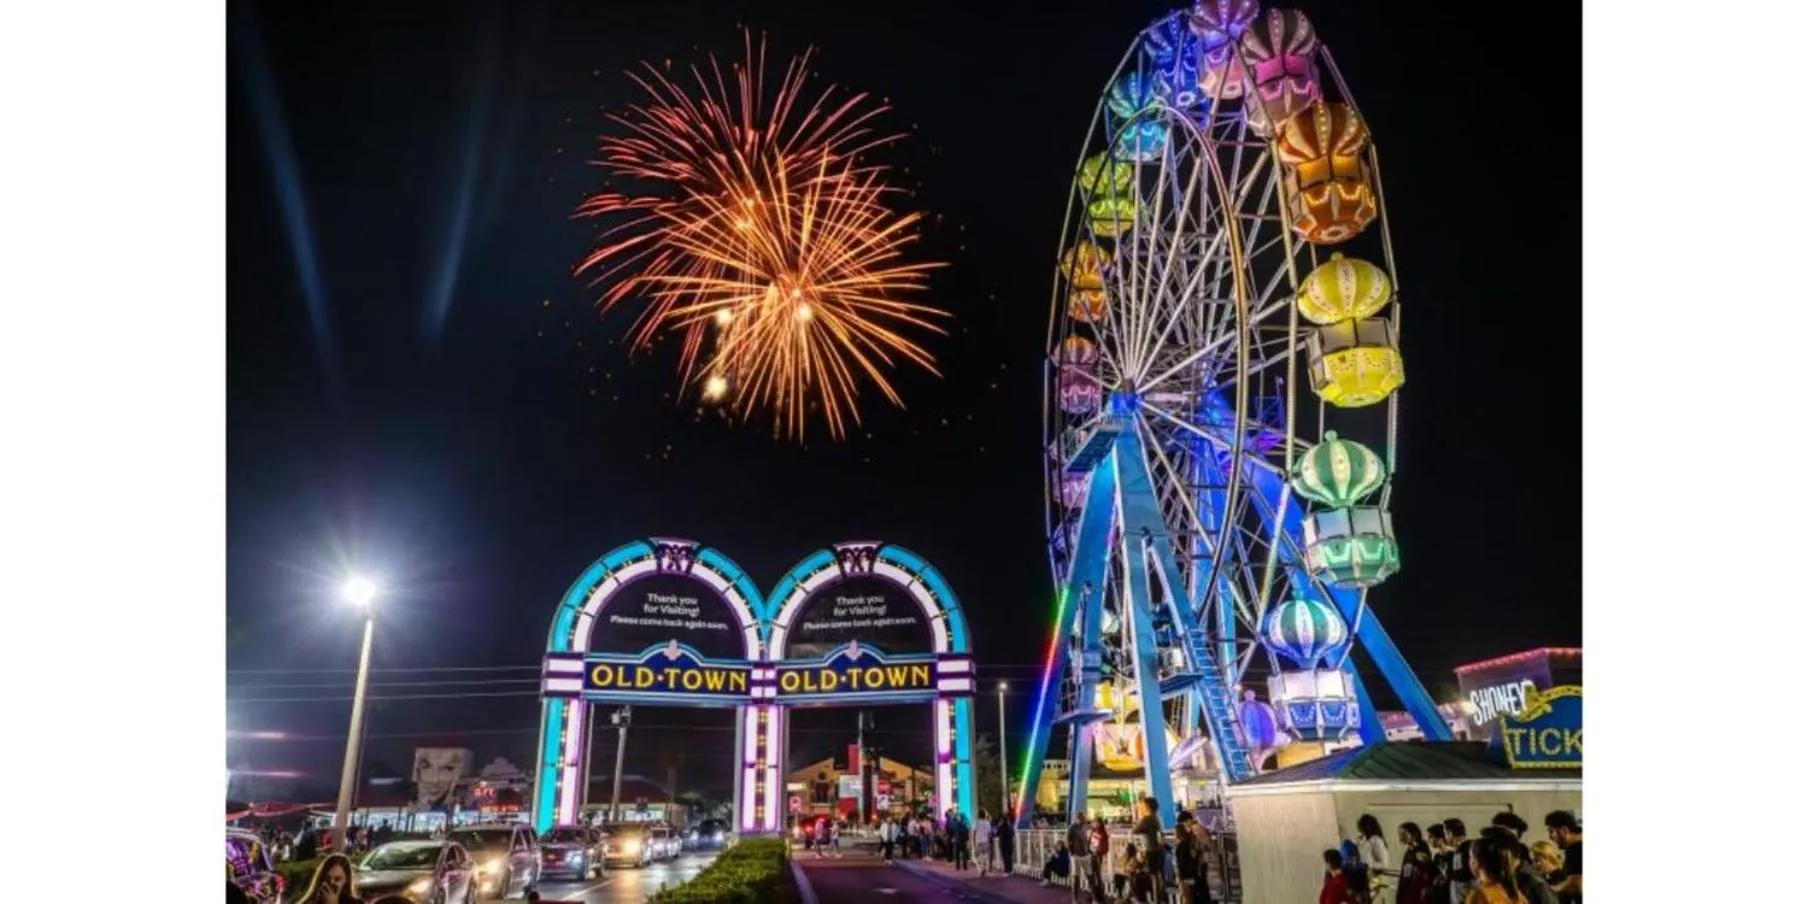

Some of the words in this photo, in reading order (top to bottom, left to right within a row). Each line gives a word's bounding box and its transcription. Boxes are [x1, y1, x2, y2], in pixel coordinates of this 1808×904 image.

[647, 592, 678, 604] Thank
[680, 596, 699, 606] you
[836, 596, 865, 605] Thank
[867, 595, 885, 604] you
[644, 603, 658, 613] for
[660, 605, 700, 618] Visiting!
[833, 606, 847, 616] for
[610, 615, 638, 624] Please
